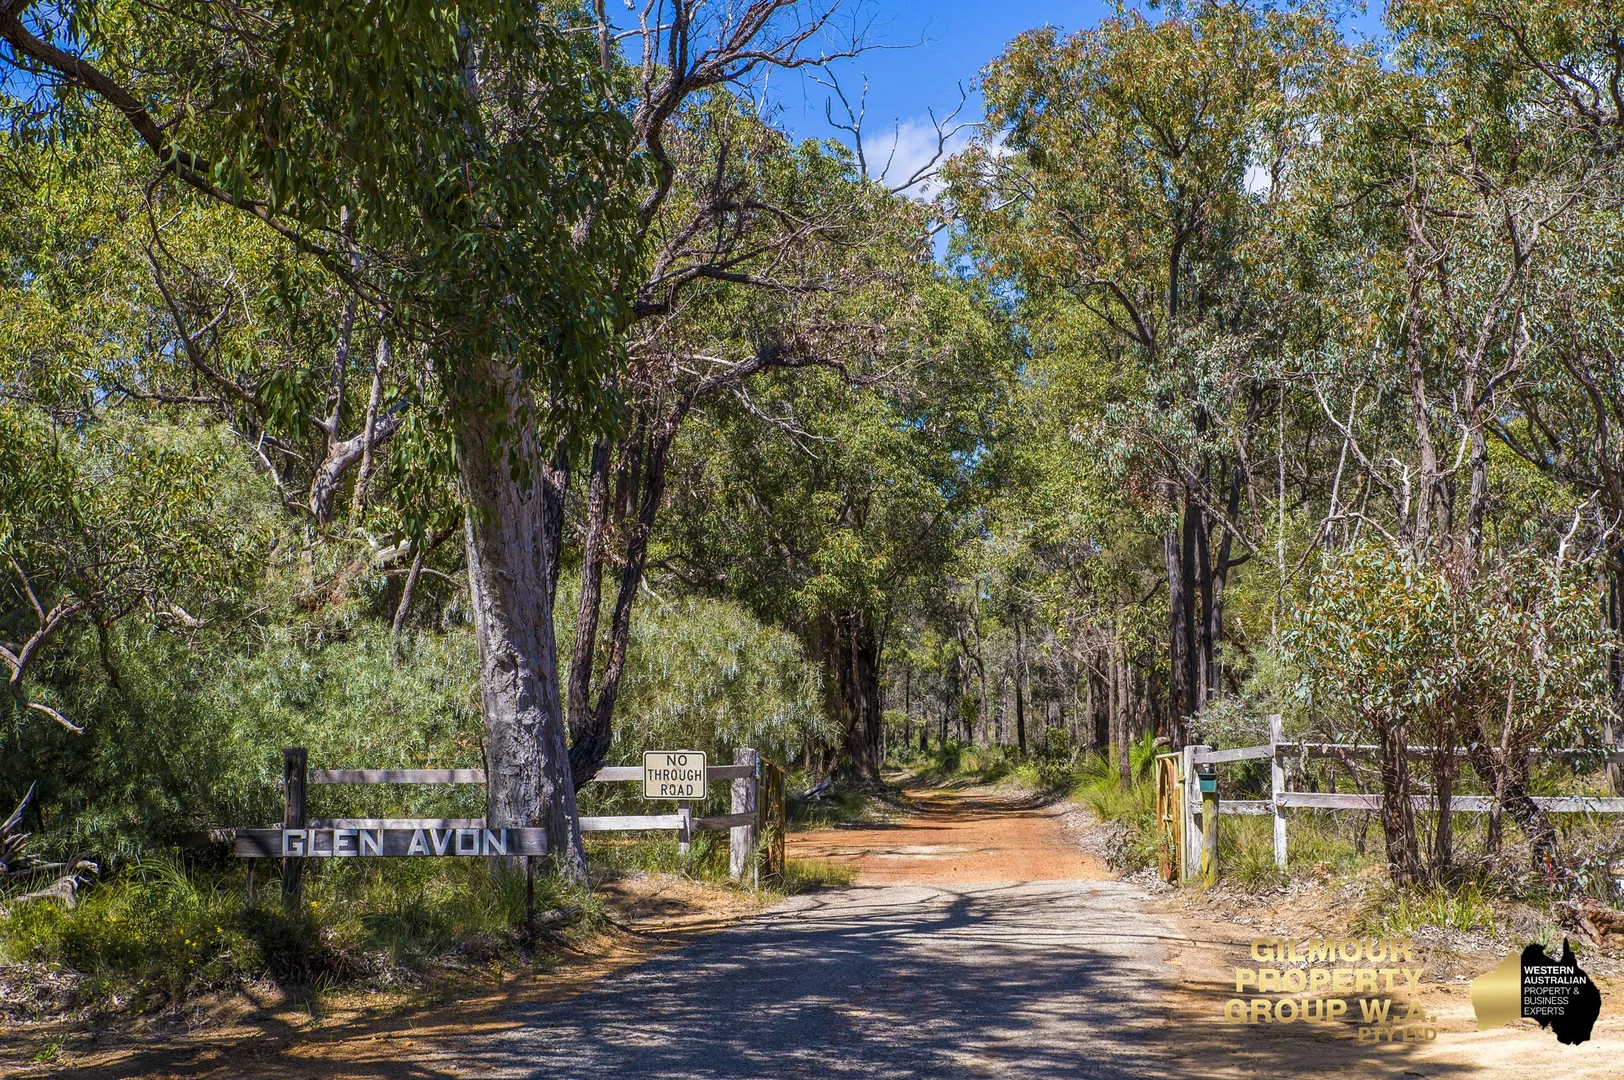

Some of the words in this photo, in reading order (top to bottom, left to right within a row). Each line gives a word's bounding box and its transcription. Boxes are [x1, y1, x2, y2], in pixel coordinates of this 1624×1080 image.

[667, 755, 687, 766] NO
[648, 769, 702, 781] THROUGH
[661, 784, 693, 796] ROAD
[282, 829, 384, 857] GLEN
[407, 829, 507, 856] AVON
